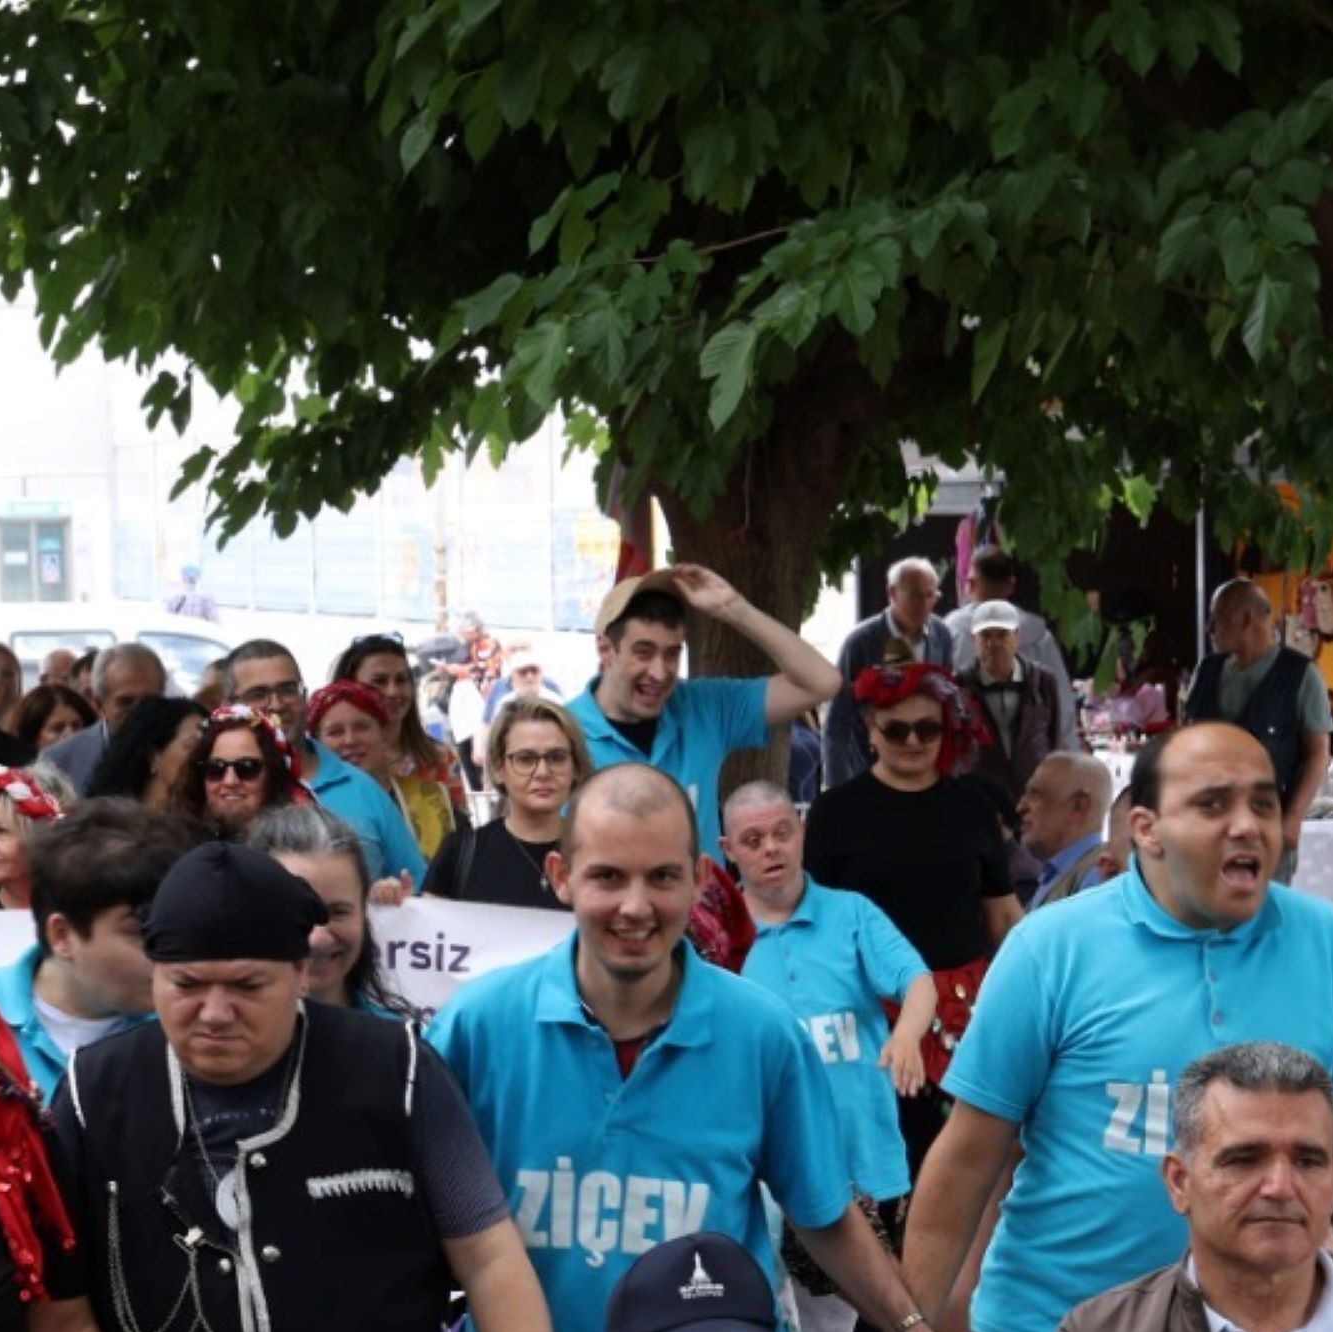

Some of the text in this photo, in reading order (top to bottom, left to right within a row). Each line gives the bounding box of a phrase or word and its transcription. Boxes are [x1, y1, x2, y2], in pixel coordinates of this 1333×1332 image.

[799, 1012, 860, 1064] EV
[1104, 1069, 1169, 1155] Zİ
[516, 1156, 710, 1267] ZİÇEV
